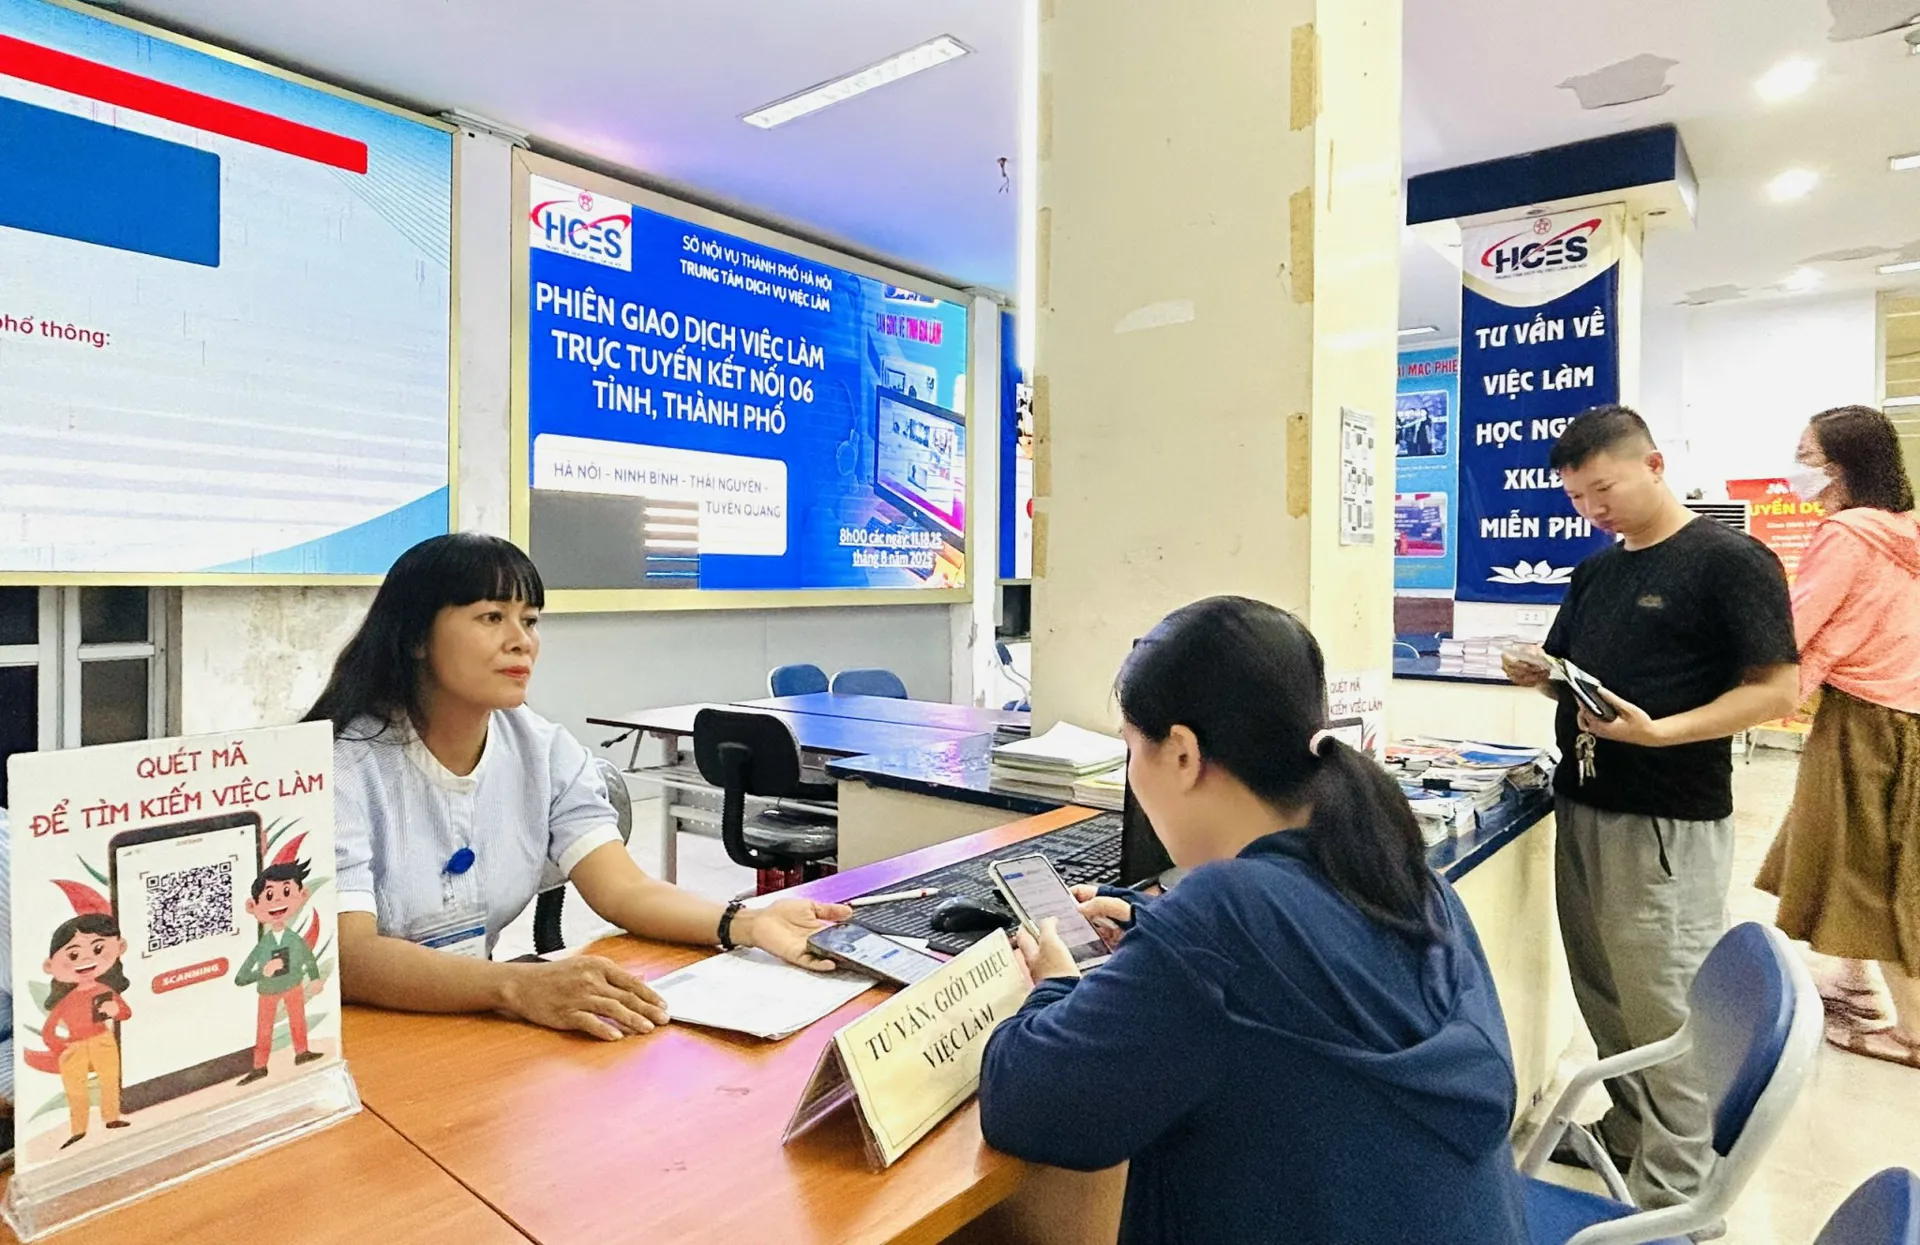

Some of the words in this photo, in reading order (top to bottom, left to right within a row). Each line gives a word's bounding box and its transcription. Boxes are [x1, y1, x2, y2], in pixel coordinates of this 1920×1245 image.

[545, 210, 622, 259] HCES
[1495, 236, 1588, 274] HCES
[683, 234, 700, 253] SỞ
[702, 240, 722, 261] NỘI
[724, 247, 739, 266] VỤ
[741, 253, 776, 275] THÀNH
[778, 264, 799, 282] PHỐ
[800, 270, 814, 286] HÀ
[816, 274, 832, 292] NỘI
[680, 259, 719, 283] TRUNG
[721, 269, 743, 290] TÂM
[746, 277, 770, 296] DỊCH
[772, 284, 786, 303] VỤ
[788, 288, 809, 308] VIỆC
[811, 293, 830, 312] LÀM
[40, 320, 111, 348] thông:
[536, 281, 615, 326] PHIÊN
[621, 302, 679, 340] GIAO
[685, 315, 736, 352] DỊCH
[740, 328, 784, 364] VIỆC
[787, 336, 825, 371] LÀM
[1476, 324, 1508, 349] TƯ
[1514, 312, 1564, 345] VẤN
[1573, 306, 1605, 338] VỀ
[551, 329, 621, 372] TRỰC
[626, 343, 701, 384] TUYẾN
[708, 353, 746, 391] KẾT
[750, 364, 785, 399] NỐI
[789, 380, 814, 404] 06
[1483, 369, 1534, 400] VIỆC
[1542, 363, 1594, 391] LÀM
[592, 375, 657, 421] TỈNH,
[662, 390, 738, 430] THÀNH
[743, 400, 786, 435] PHỐ
[1476, 420, 1523, 449] HỌC
[614, 467, 646, 484] NINH
[650, 468, 679, 487] BÌNH
[690, 472, 715, 489] THÁI
[744, 503, 781, 519] QUANG
[1481, 509, 1539, 539] MIỄN
[137, 747, 202, 779] QUÉT
[212, 740, 247, 770] MÃ
[29, 799, 69, 837] ĐỂ
[81, 799, 129, 829] TÌM
[140, 782, 201, 820] KIẾM
[213, 777, 270, 808] VIỆC
[278, 770, 323, 797] LÀM
[162, 963, 220, 986] SCANNING
[865, 1022, 892, 1061] TƯ
[934, 975, 969, 1013] GIỚI
[966, 948, 1009, 989] THIỆU
[922, 1027, 963, 1069] VIỆC
[961, 1003, 995, 1042] LÀM
